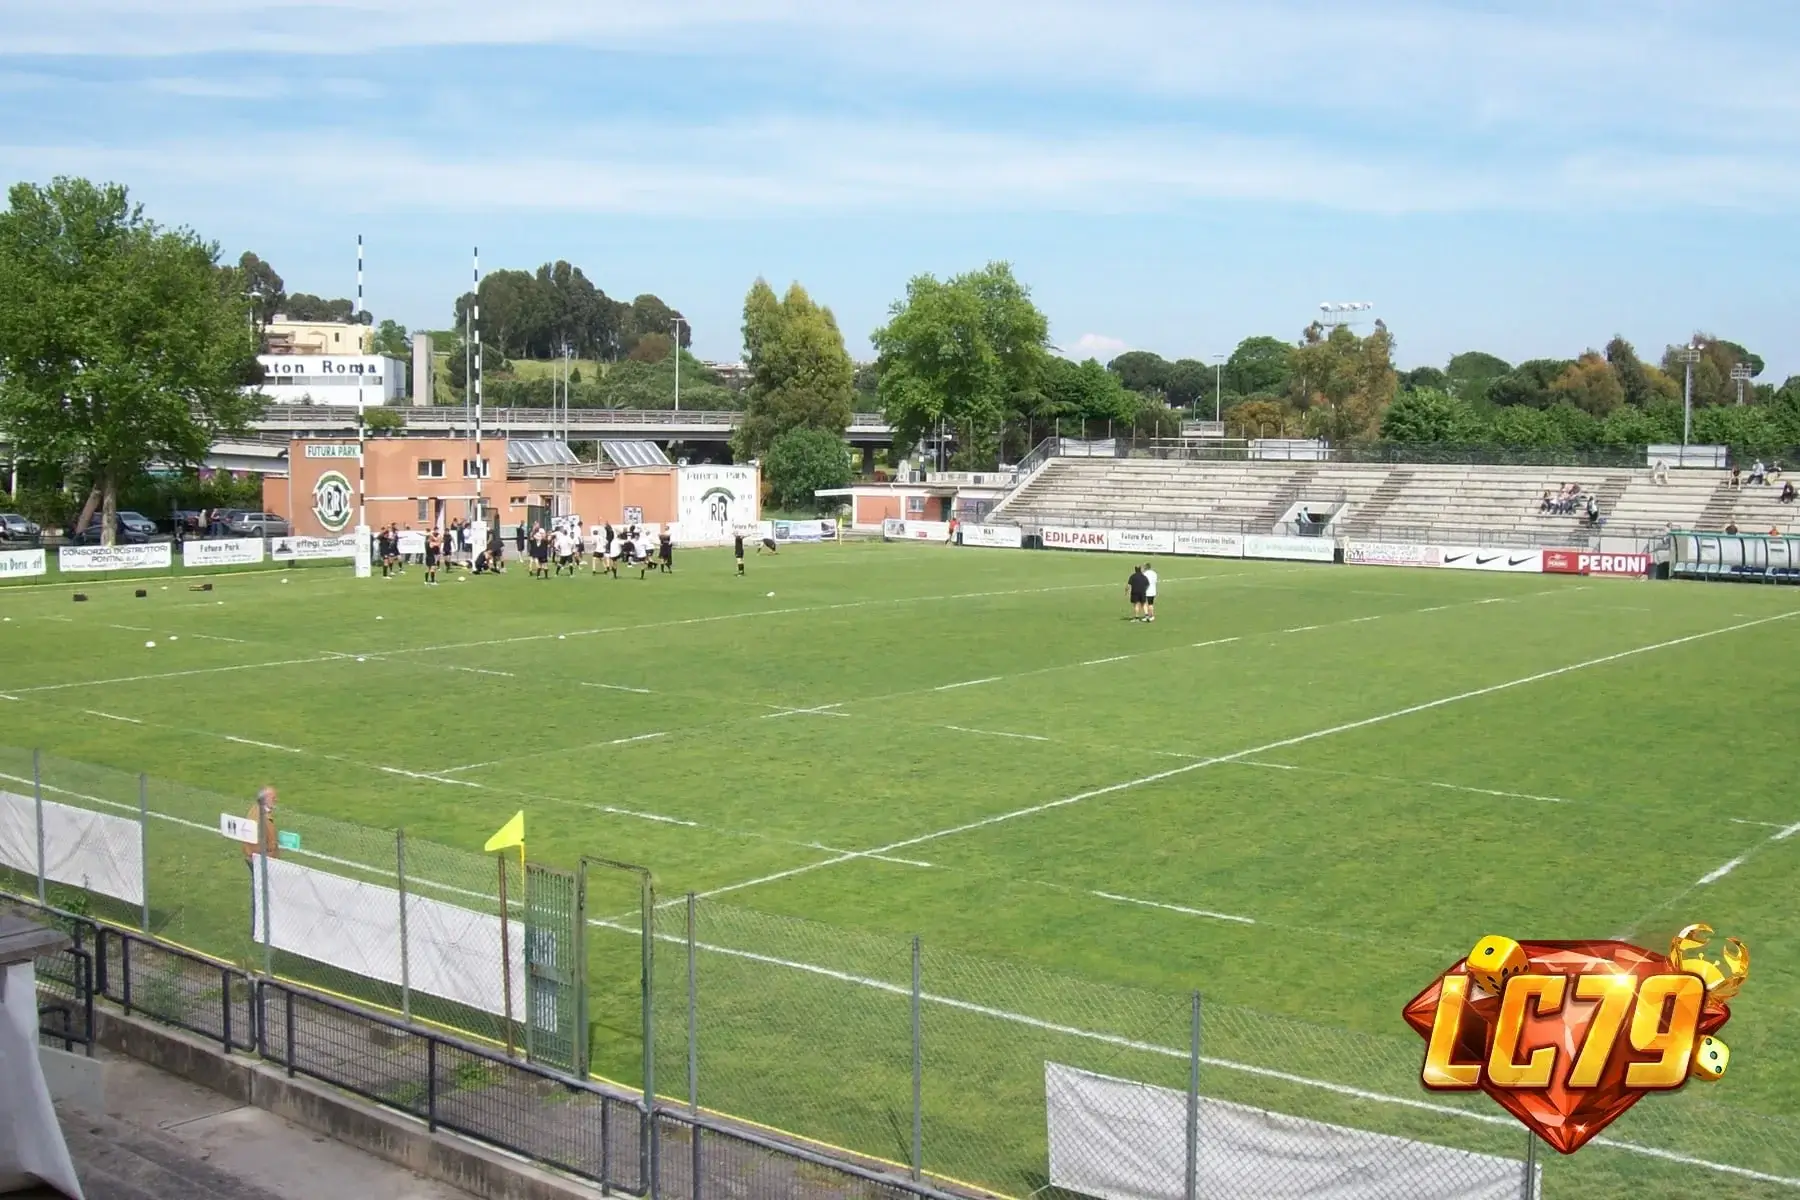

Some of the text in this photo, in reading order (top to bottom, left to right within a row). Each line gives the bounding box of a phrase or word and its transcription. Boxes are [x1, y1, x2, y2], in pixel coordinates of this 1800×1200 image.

[264, 360, 376, 374] aton Roma
[308, 445, 357, 456] FUTURA PARK
[1045, 531, 1105, 545] EDILPARK
[1121, 531, 1154, 541] Futura Park
[200, 542, 241, 553] Futura Park
[1578, 554, 1646, 573] PERONI
